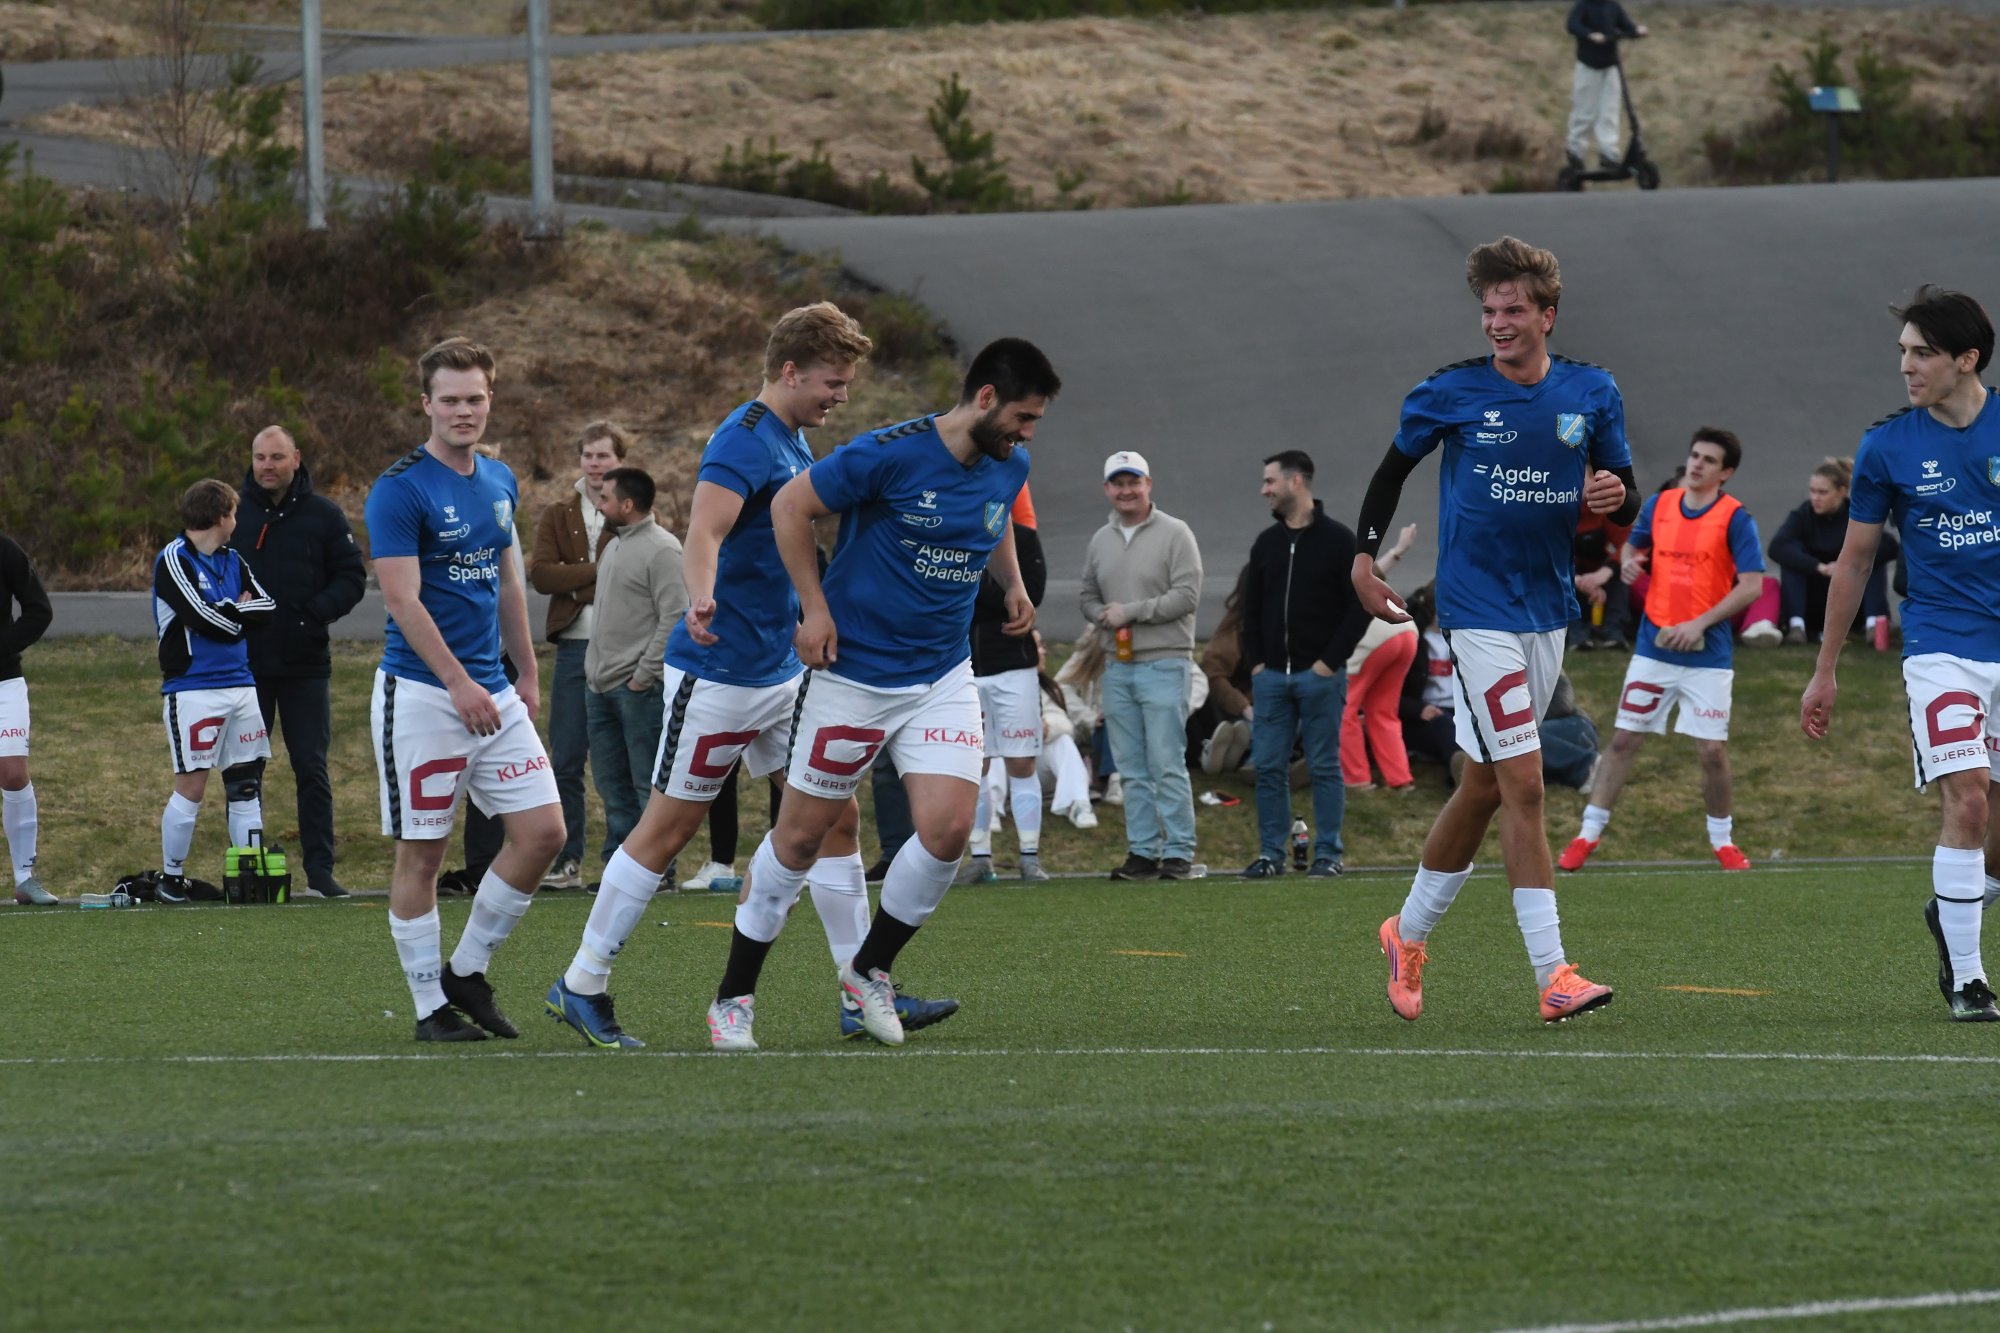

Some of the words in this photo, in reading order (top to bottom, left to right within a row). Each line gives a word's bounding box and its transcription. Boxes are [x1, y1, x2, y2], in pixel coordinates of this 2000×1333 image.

[1490, 464, 1550, 485] Agder
[1490, 483, 1579, 504] Sparebank
[1937, 510, 1992, 531] Agder
[450, 546, 495, 565] Agder
[917, 544, 971, 563] Agder
